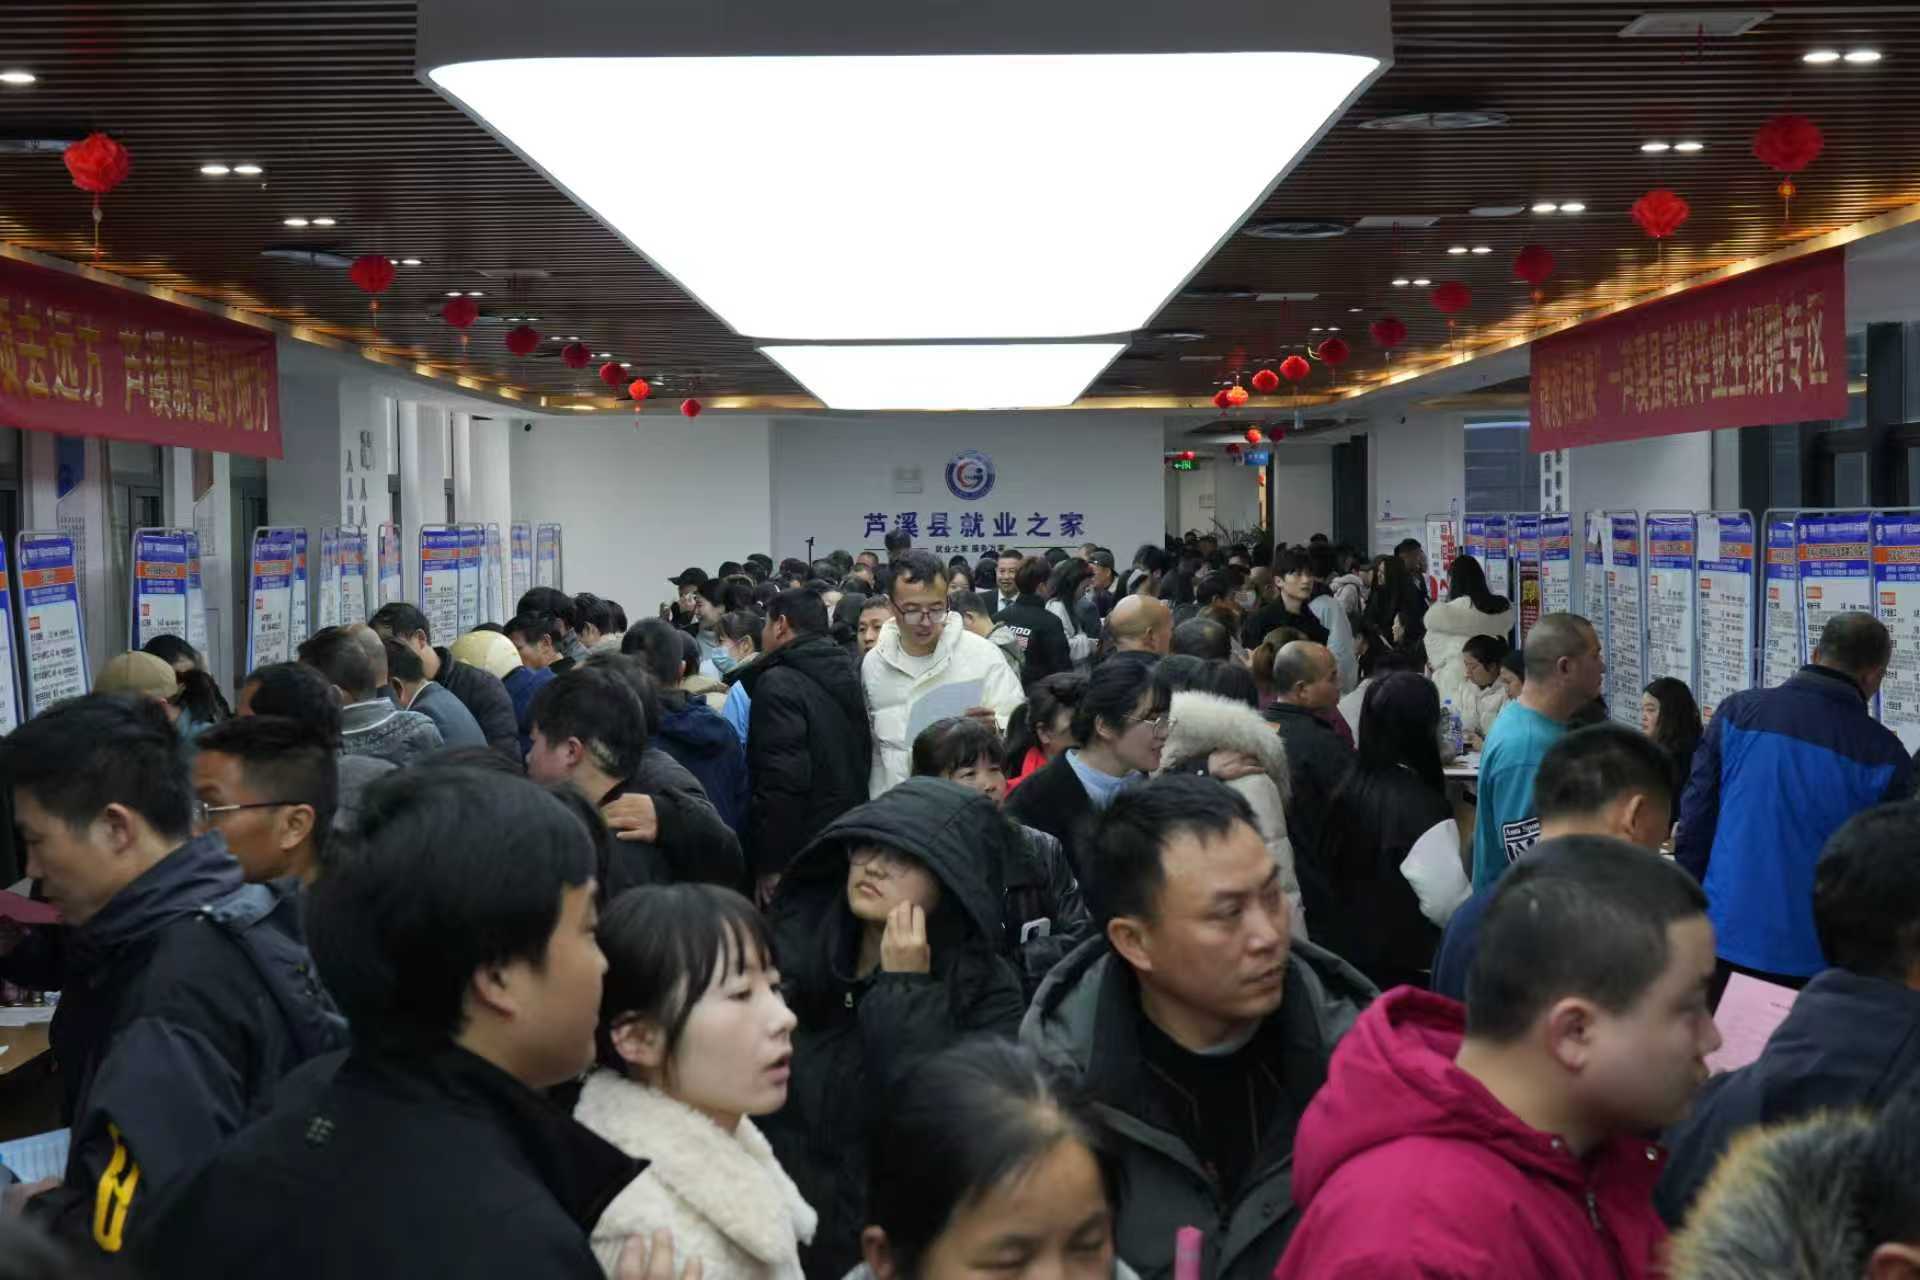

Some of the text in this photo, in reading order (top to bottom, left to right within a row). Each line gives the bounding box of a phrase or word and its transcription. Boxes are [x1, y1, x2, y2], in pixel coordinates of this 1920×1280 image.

[863, 511, 1085, 539] 芦溪县就业之家
